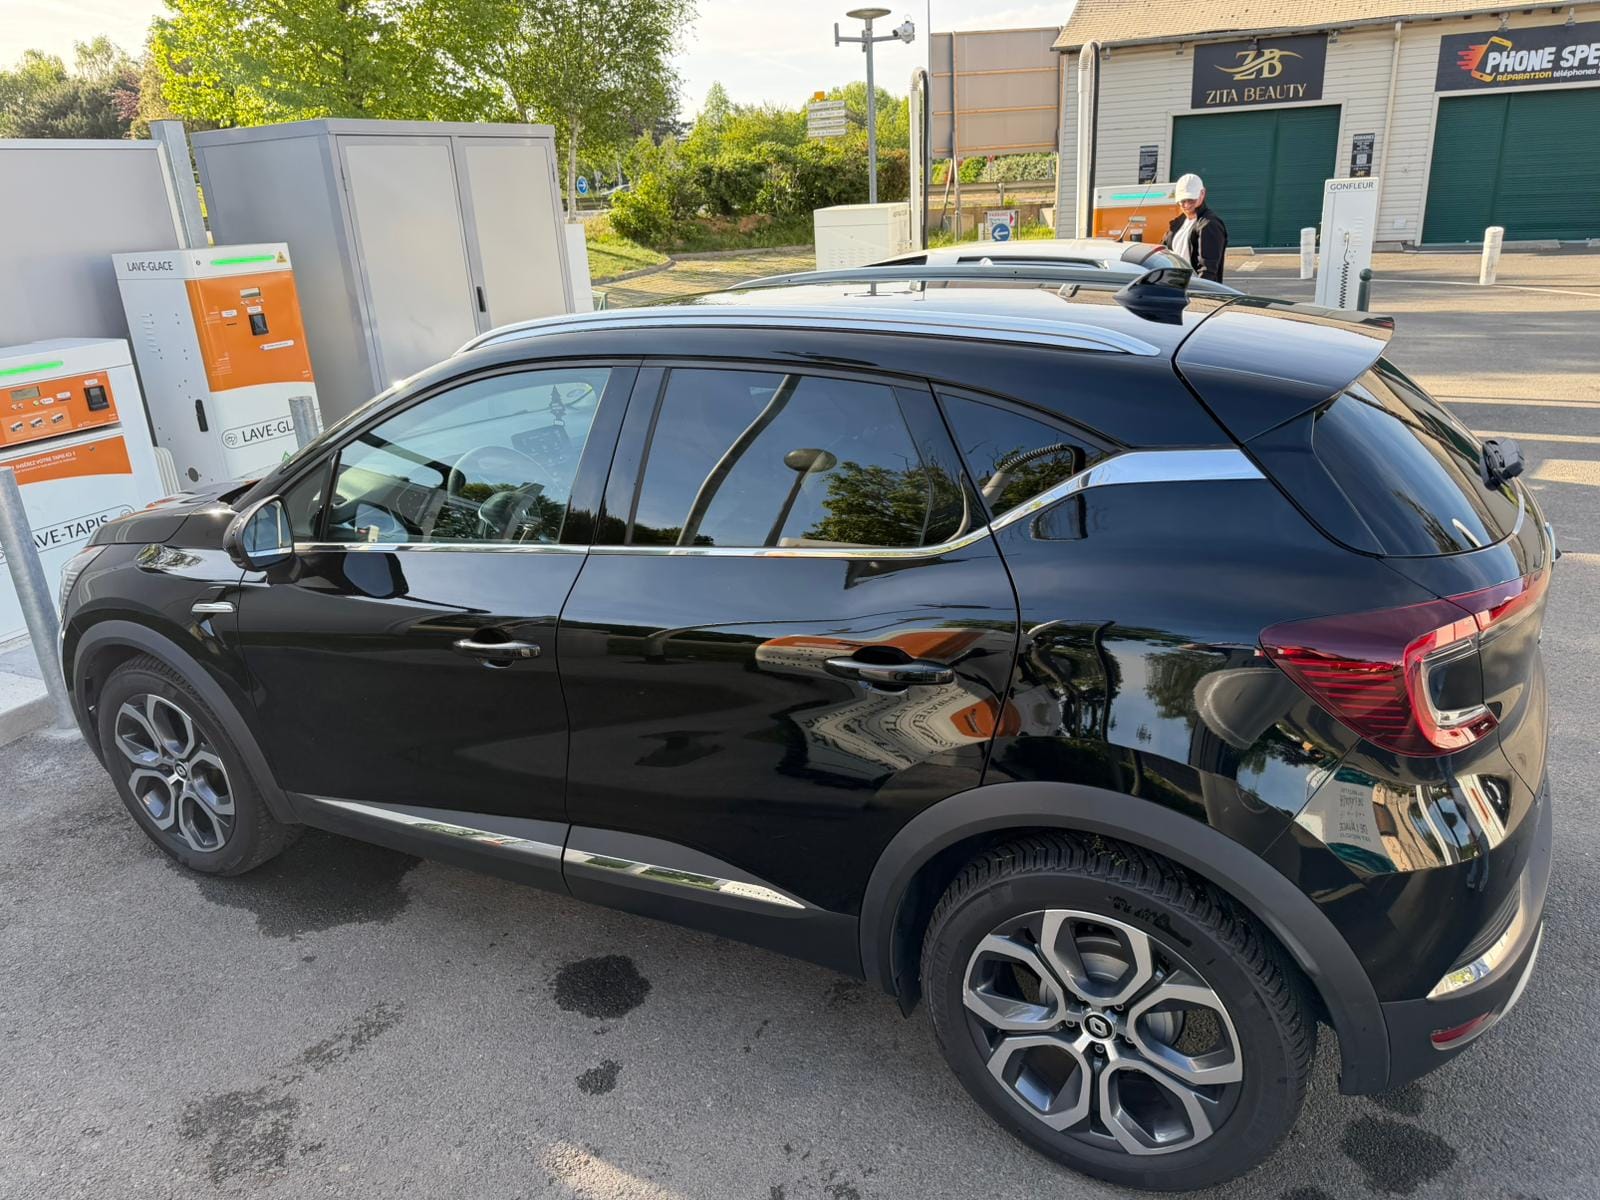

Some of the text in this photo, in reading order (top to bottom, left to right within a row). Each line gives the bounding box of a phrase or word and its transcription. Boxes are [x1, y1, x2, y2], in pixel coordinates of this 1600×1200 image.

[1485, 42, 1600, 73] PHONE SPE
[1553, 68, 1596, 78] téléphones
[1206, 83, 1306, 104] ZITA BEAUTY
[1330, 181, 1374, 190] GONFLEUR
[126, 261, 174, 271] LAVE-GLACE
[242, 420, 296, 442] LAVE-GL
[34, 515, 108, 548] VE-TAPIS
